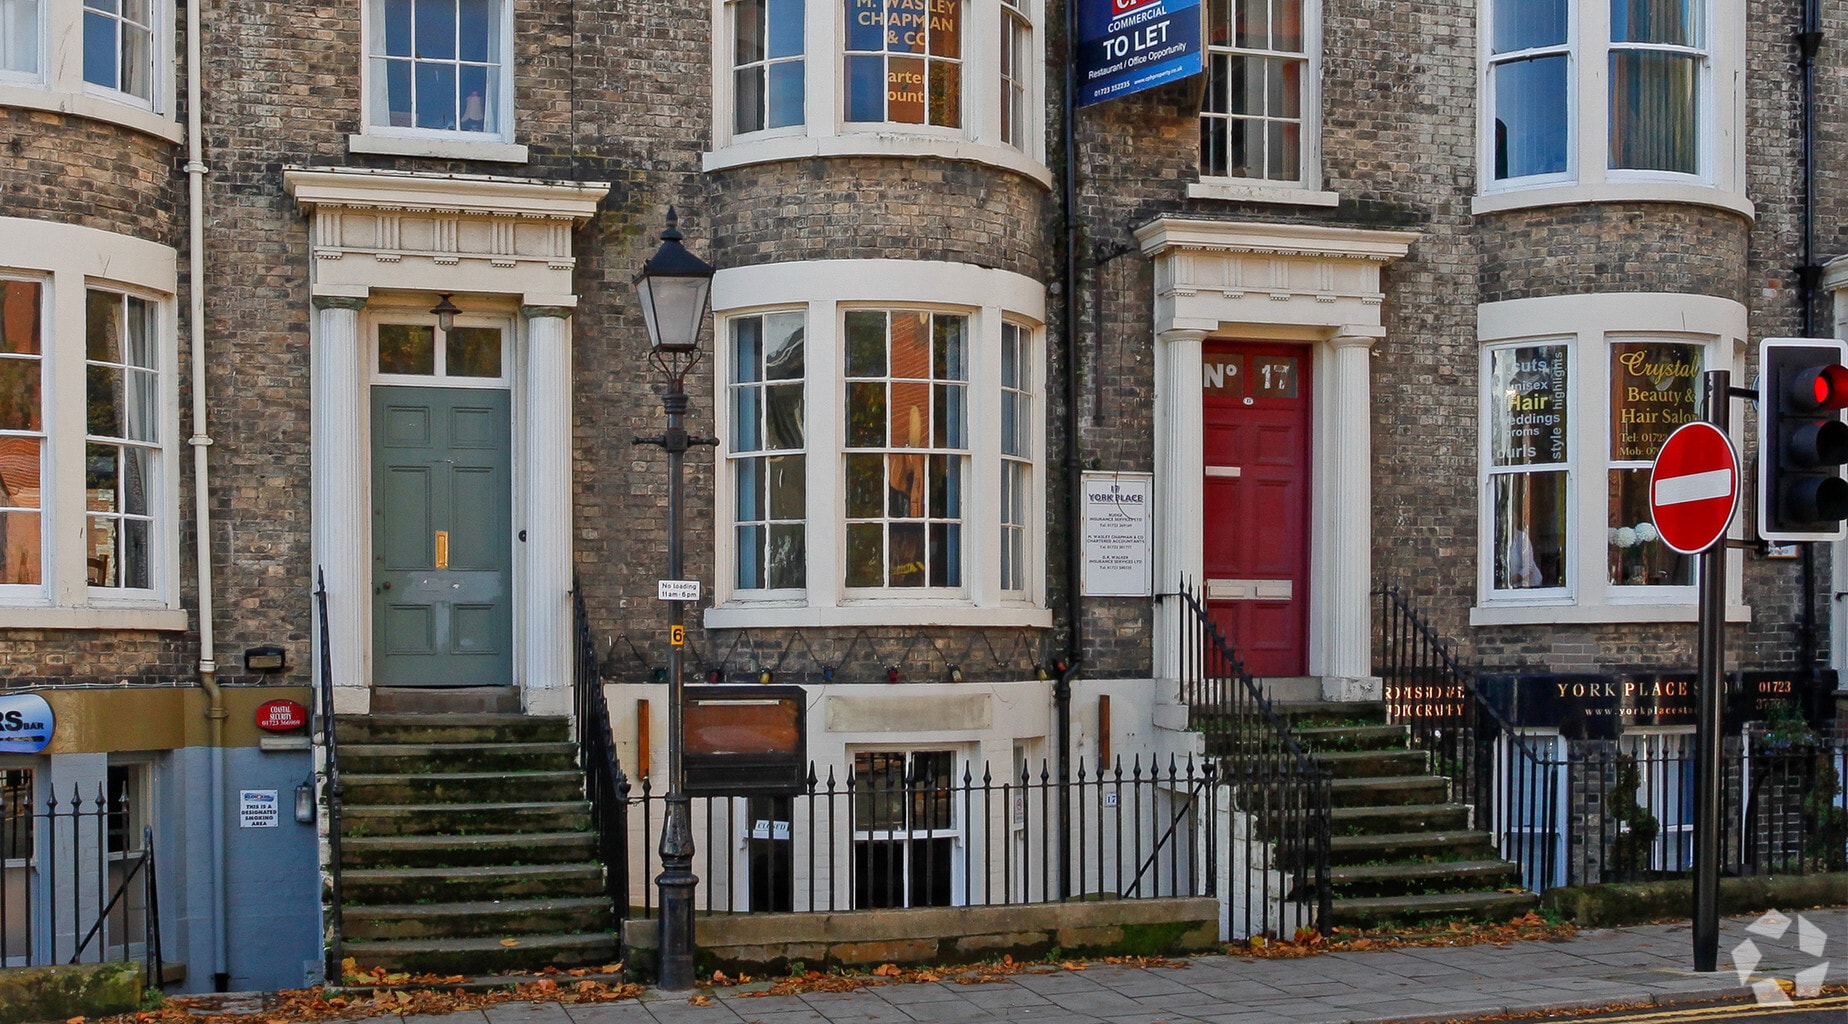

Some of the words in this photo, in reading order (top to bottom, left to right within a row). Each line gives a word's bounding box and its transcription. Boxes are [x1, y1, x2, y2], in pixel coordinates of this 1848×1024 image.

[857, 11, 953, 32] CHAPMAN
[1107, 6, 1168, 33] COMMERCIAL
[887, 30, 899, 44] &
[1102, 35, 1129, 61] TO
[1134, 20, 1171, 52] LET
[1088, 61, 1123, 79] Restaurant
[1127, 55, 1147, 67] Office
[1148, 42, 1187, 61] Opportunity
[1620, 351, 1700, 384] Crystal
[1552, 351, 1566, 410] highlights
[1627, 387, 1682, 407] Beauty
[1684, 388, 1695, 403] &
[1508, 413, 1561, 426] eddings
[1621, 407, 1659, 424] Hair
[1550, 427, 1565, 459] style
[1620, 433, 1639, 442] Tel:
[1619, 446, 1644, 456] Mob:
[1088, 493, 1114, 502] YORK
[1115, 494, 1144, 503] PLACE
[673, 628, 682, 643] 6
[1557, 682, 1616, 697] YORK
[1624, 681, 1688, 697] PLACE
[1758, 681, 1792, 693] 01723
[23, 722, 45, 730] BAR
